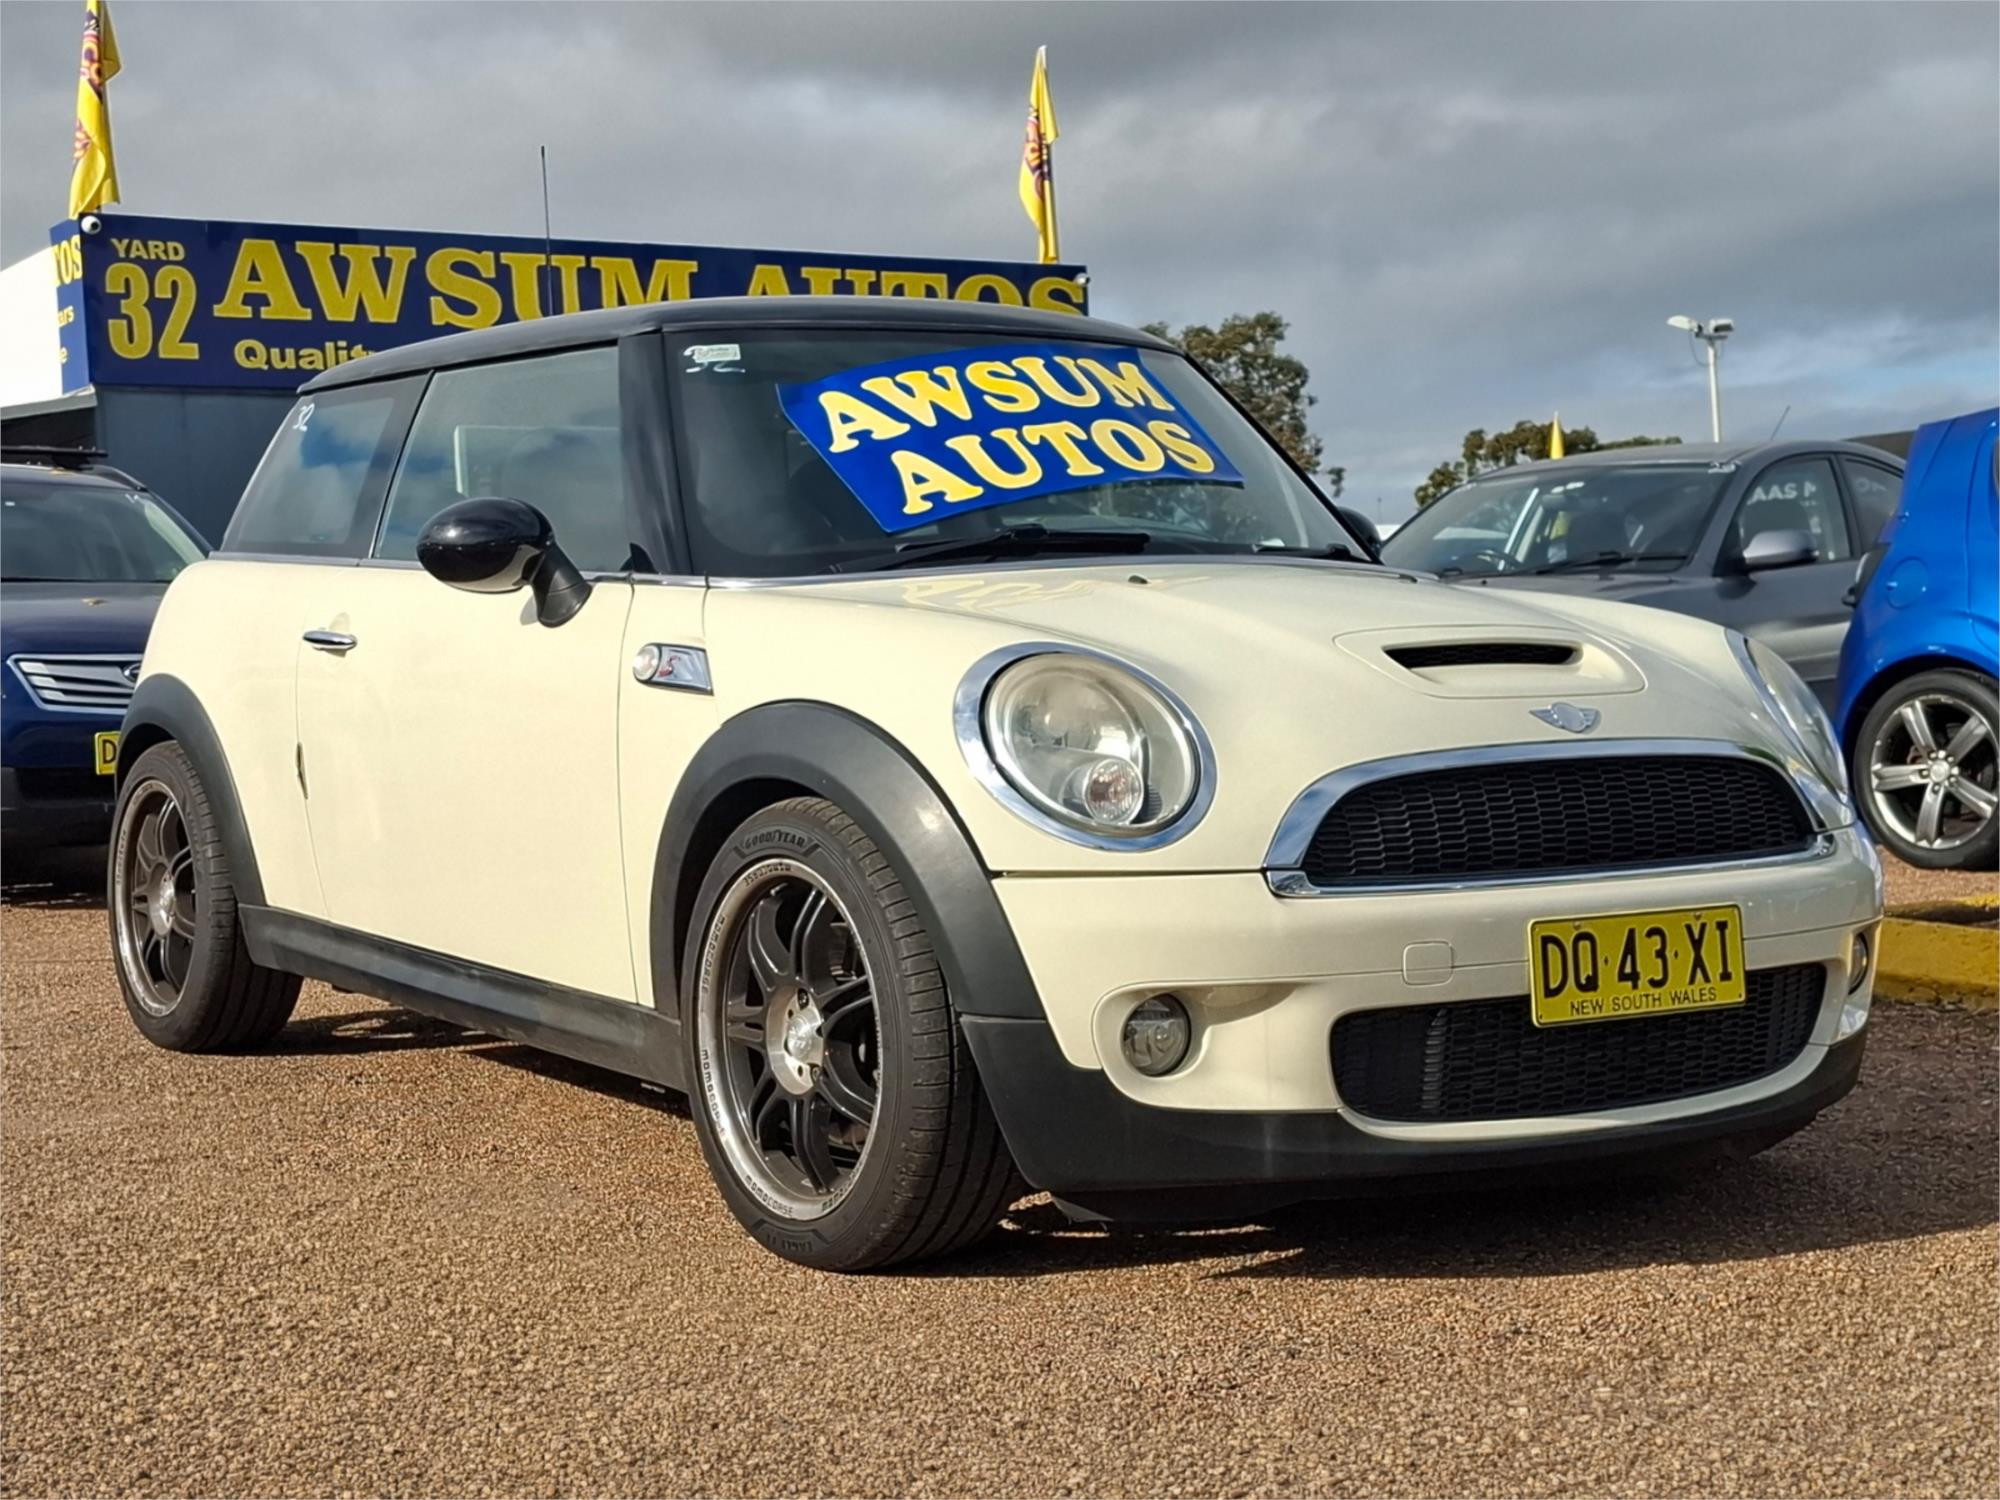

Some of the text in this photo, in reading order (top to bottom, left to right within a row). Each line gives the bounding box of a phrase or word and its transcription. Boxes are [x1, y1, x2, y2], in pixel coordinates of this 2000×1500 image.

[110, 238, 185, 261] YARD
[213, 238, 698, 330] AWSUM
[105, 262, 199, 359] 32
[234, 339, 375, 370] Qualit
[818, 356, 1175, 452] AWSUM
[891, 419, 1215, 515] AUTOS
[102, 739, 117, 764] D
[744, 829, 806, 849] GOODYEAR
[1570, 987, 1717, 1016] NEW SOUTH WALES
